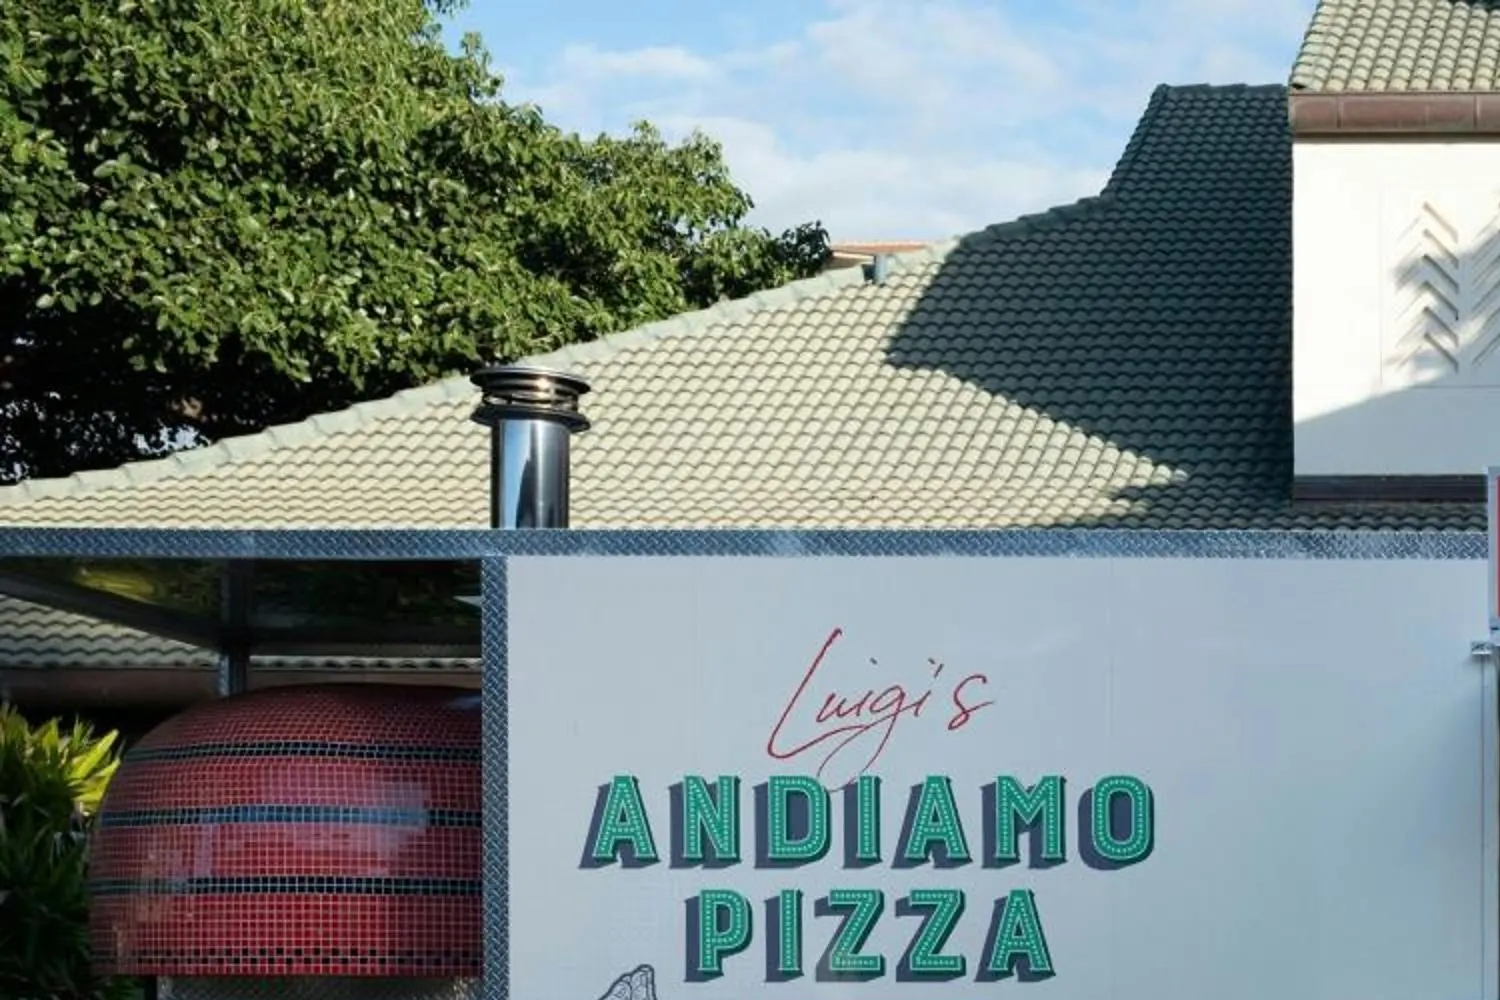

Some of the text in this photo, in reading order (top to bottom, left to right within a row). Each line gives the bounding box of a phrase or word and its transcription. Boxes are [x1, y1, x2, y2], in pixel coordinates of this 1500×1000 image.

[767, 627, 995, 792] Luigi's
[578, 774, 1156, 871] ANDIAMO
[683, 888, 1056, 983] PIZZA
